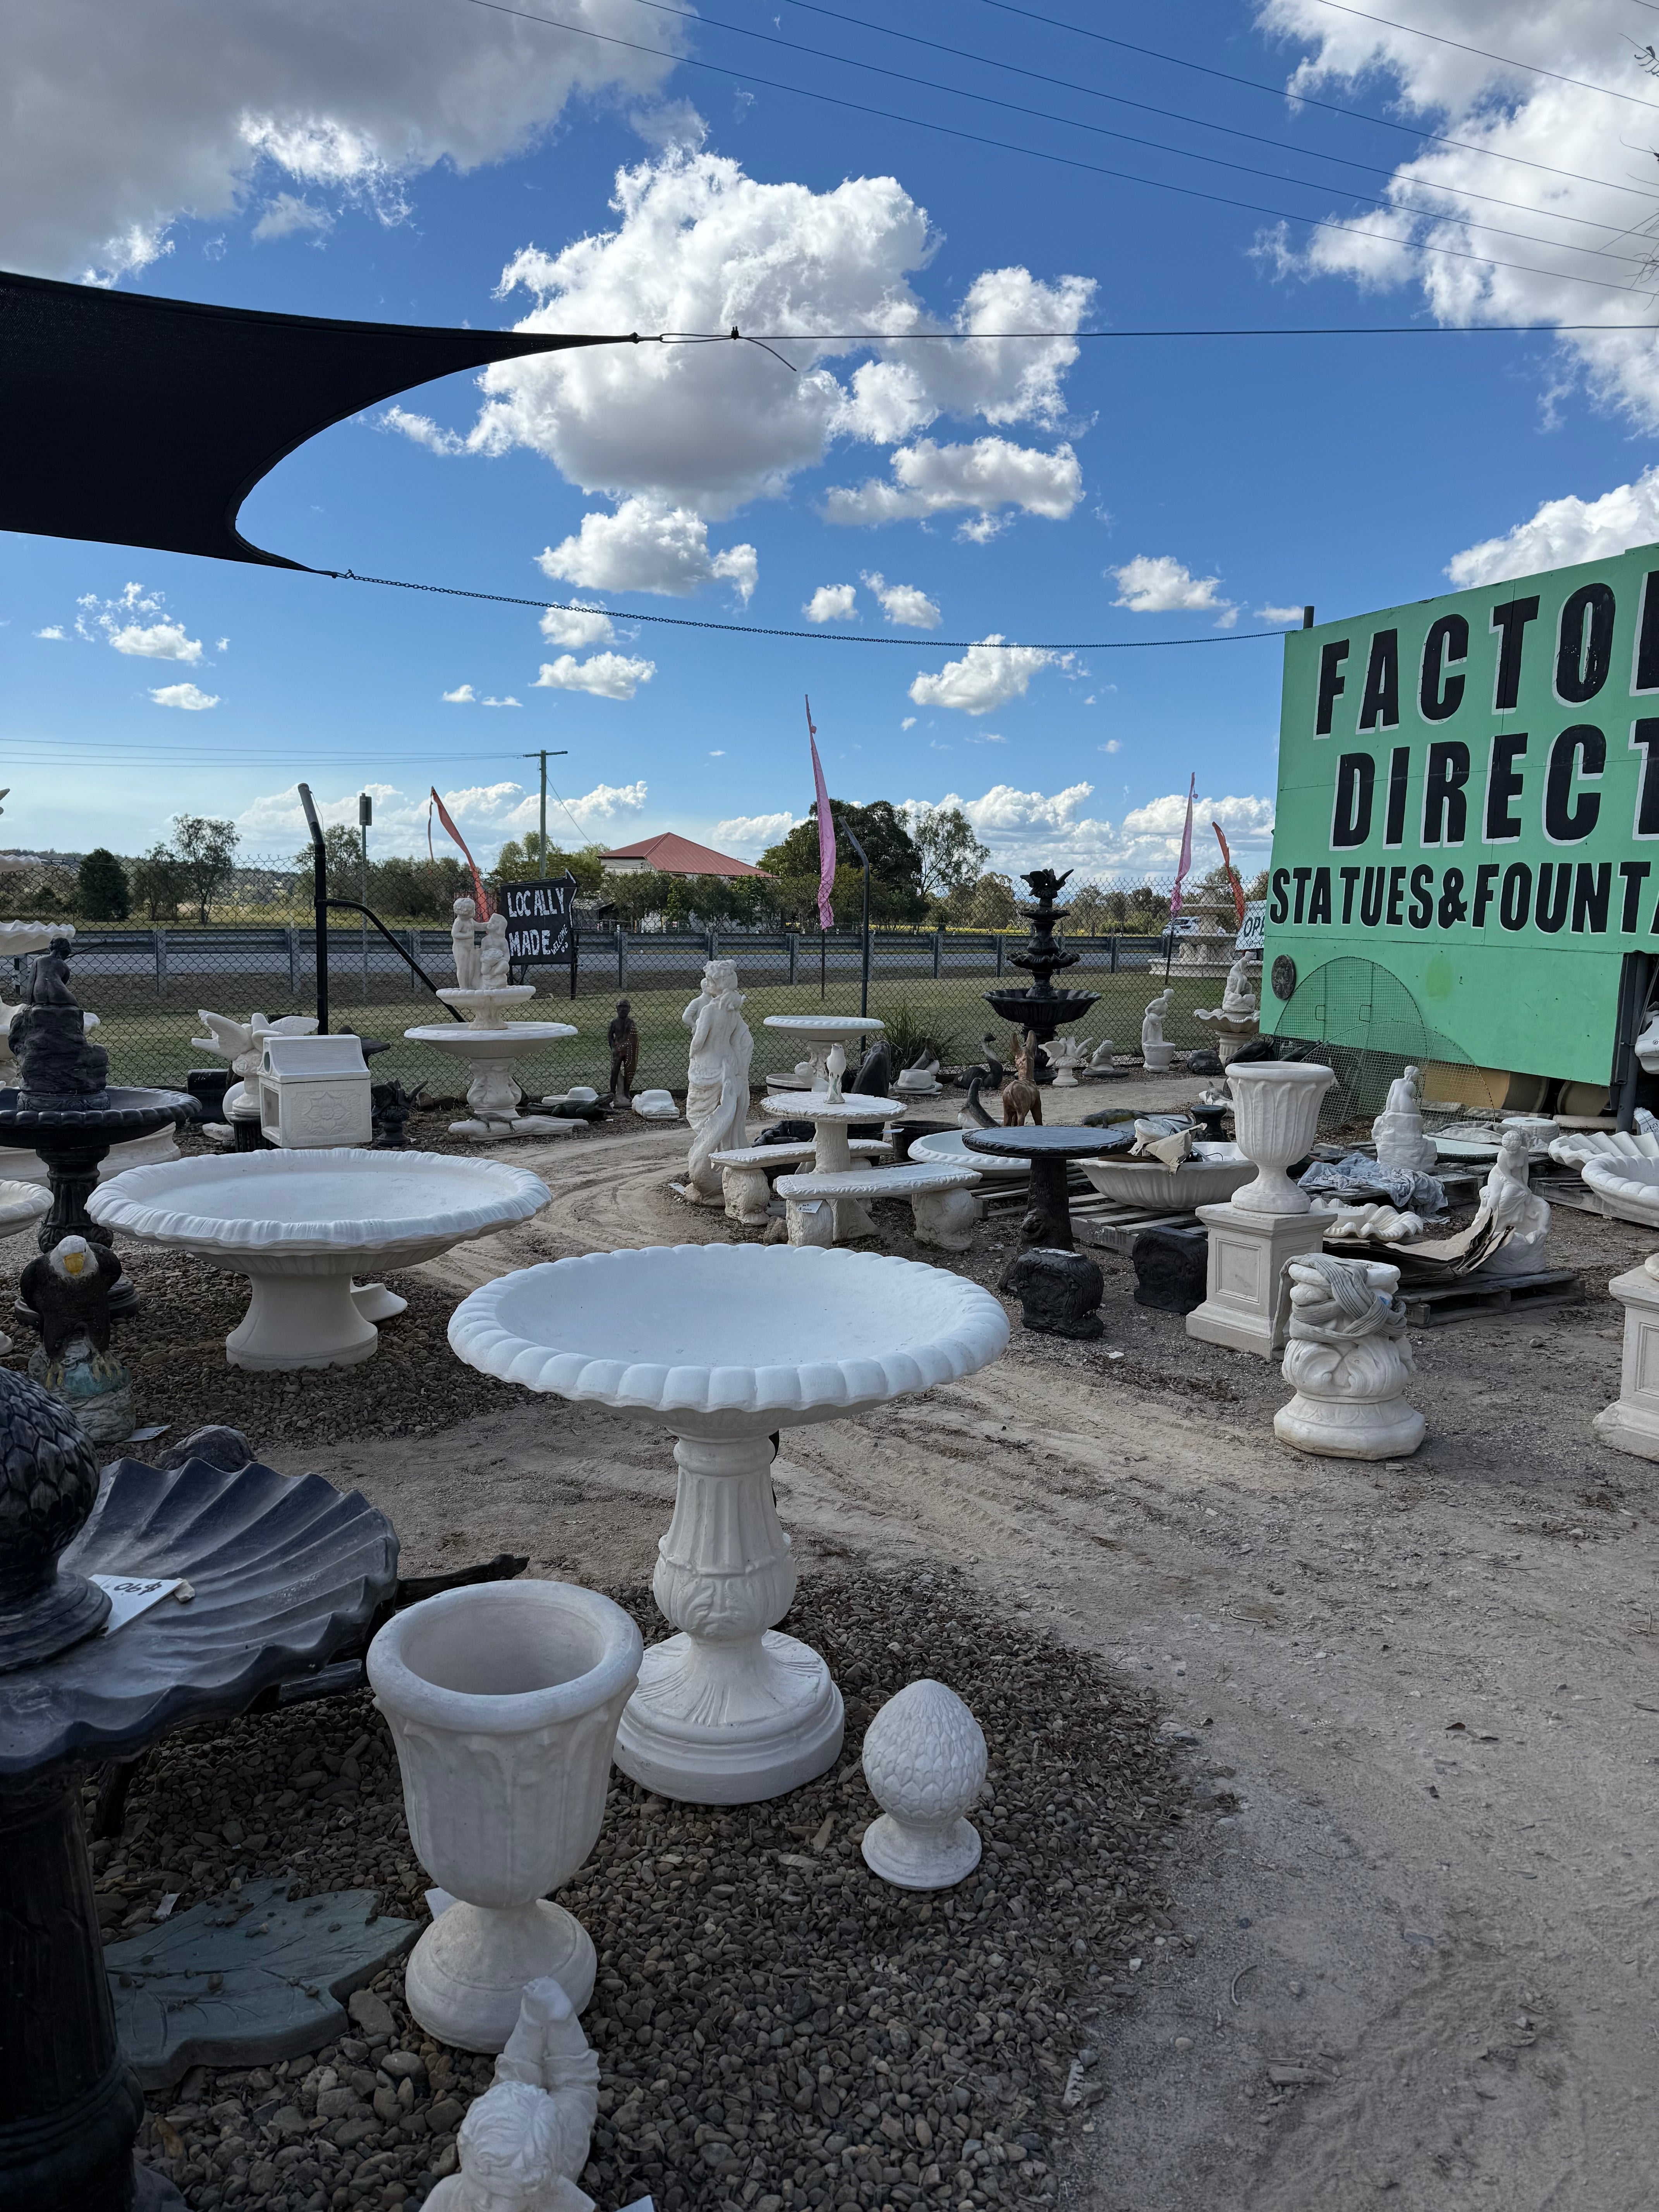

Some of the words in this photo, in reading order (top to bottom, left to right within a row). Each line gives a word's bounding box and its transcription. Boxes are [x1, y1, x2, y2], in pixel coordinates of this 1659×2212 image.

[507, 888, 564, 917] LOCALLY
[508, 929, 551, 956] MADE
[551, 924, 568, 955] WELCOME
[114, 1581, 162, 1595] $90
